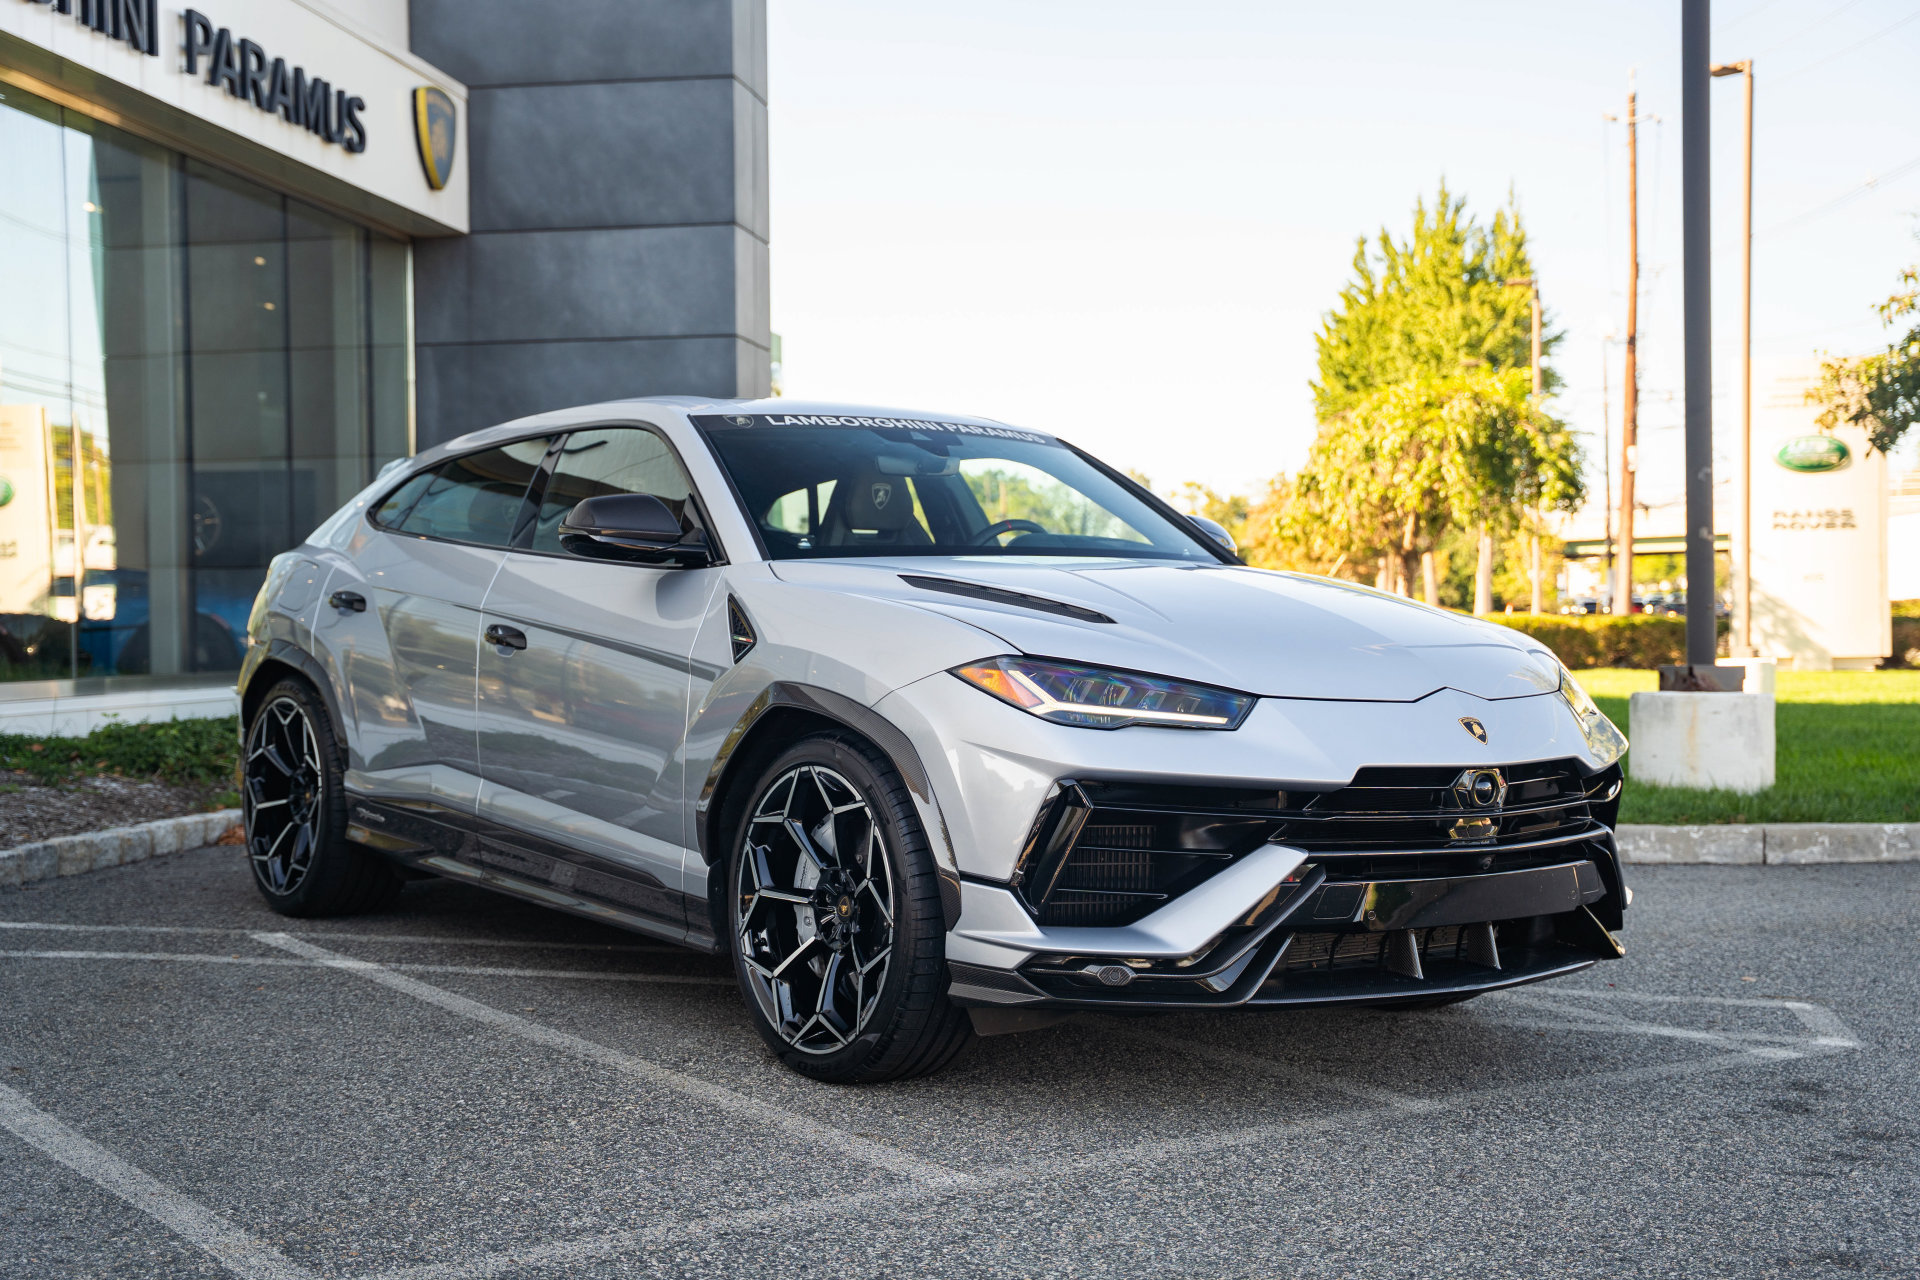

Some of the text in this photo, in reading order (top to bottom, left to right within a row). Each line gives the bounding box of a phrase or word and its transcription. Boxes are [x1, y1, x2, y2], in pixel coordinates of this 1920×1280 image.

[184, 8, 366, 154] PARAMUS
[764, 415, 1047, 444] LAMBORGHINI PARAMUS
